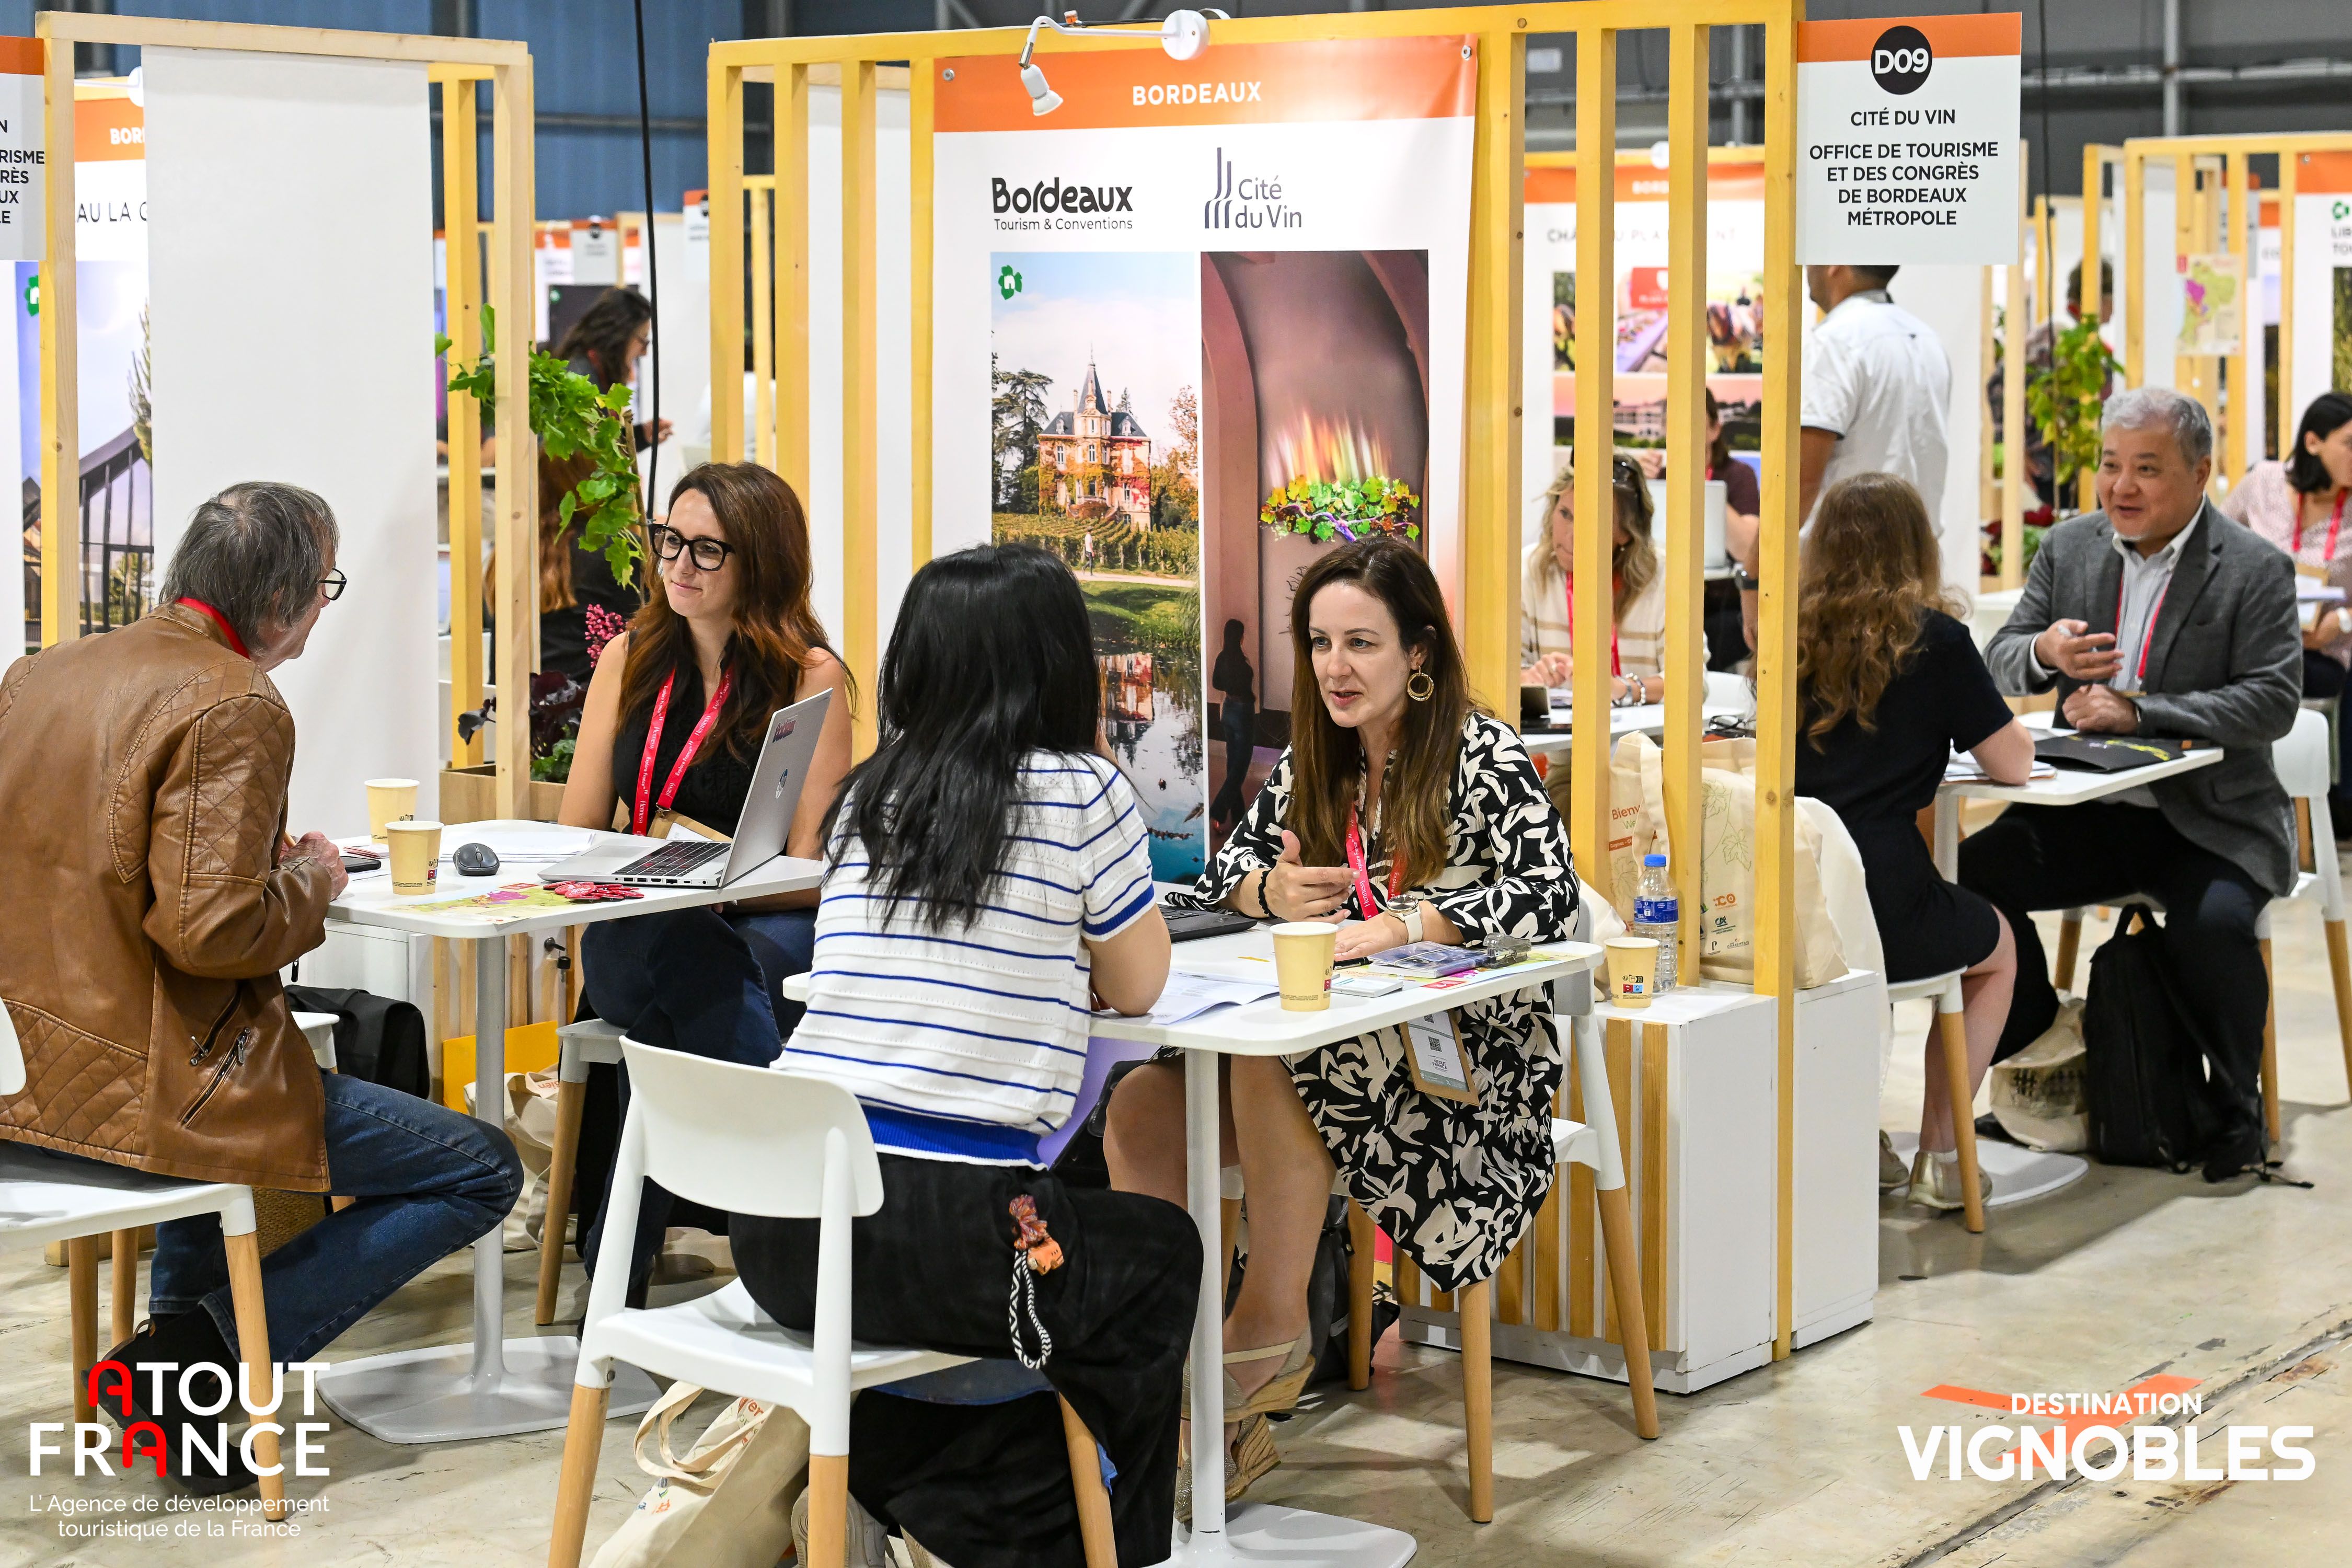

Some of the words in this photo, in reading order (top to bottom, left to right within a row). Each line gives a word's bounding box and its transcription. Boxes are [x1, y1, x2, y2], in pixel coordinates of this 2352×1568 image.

[1874, 48, 1929, 74] D09
[1133, 81, 1262, 106] BORDEAUX
[1851, 107, 1889, 126] CITÉ
[1895, 111, 1919, 125] DU
[1924, 109, 1956, 125] VIN
[110, 127, 145, 145] BOR
[1809, 144, 1872, 160] OFFICE
[1878, 144, 1901, 158] DE
[1906, 142, 1998, 158] TOURISME
[1827, 167, 1848, 181] ET
[1853, 167, 1887, 181] DES
[1892, 161, 1979, 181] CONGRÈS
[991, 177, 1133, 213] Bordeaux
[1239, 175, 1282, 200] Cité
[1838, 189, 1862, 203] DE
[1867, 188, 1967, 203] BORDEAUX
[109, 202, 131, 222] LA
[1235, 205, 1262, 228] du
[1266, 204, 1301, 228] Vin
[1848, 207, 1957, 226] MÉTROPOLE
[994, 218, 1040, 230] Tourism
[1044, 218, 1052, 229] &
[1056, 217, 1133, 229] Conventions
[643, 757, 651, 773] Explore
